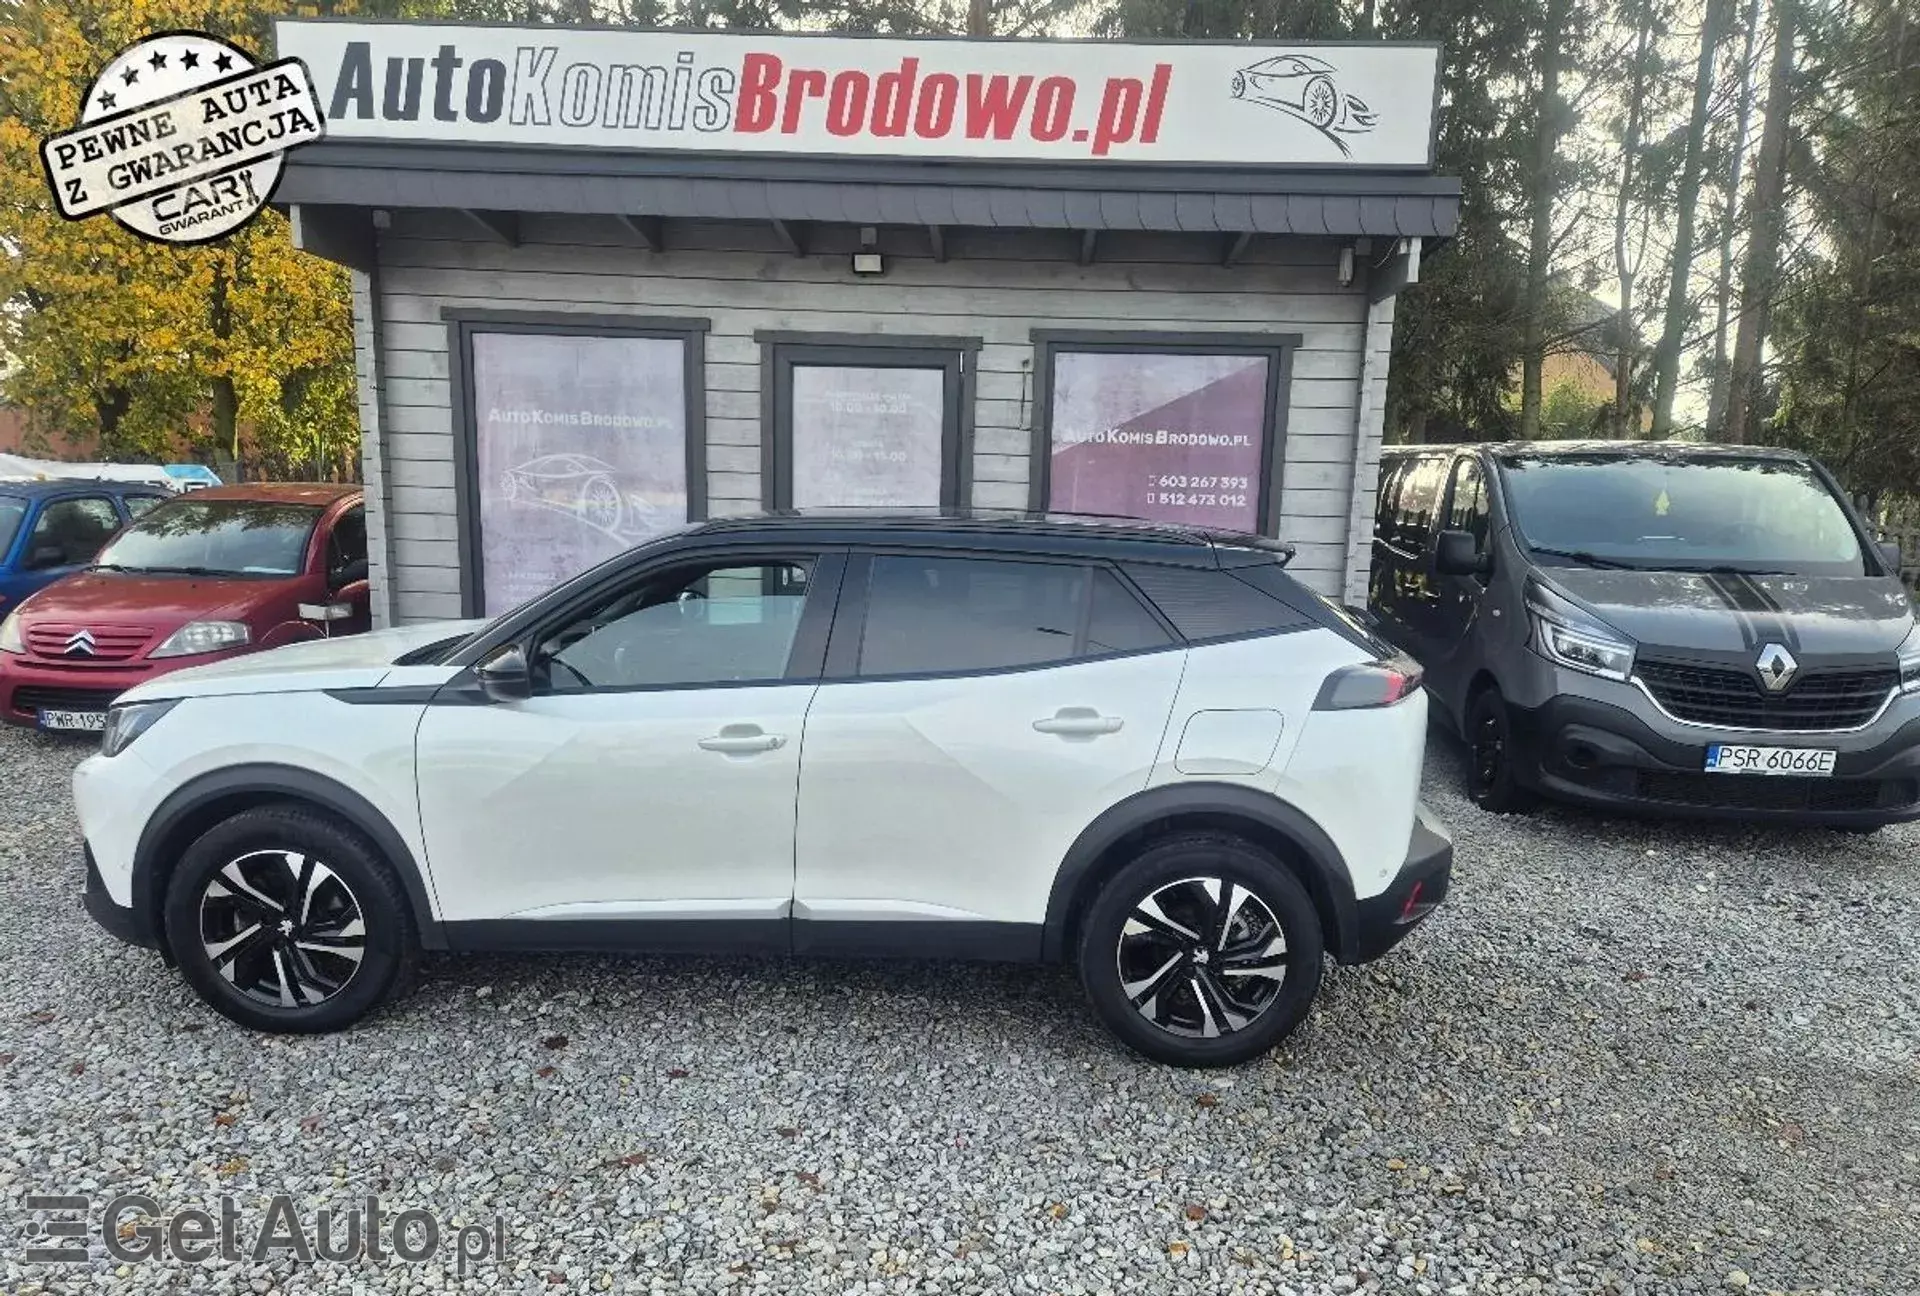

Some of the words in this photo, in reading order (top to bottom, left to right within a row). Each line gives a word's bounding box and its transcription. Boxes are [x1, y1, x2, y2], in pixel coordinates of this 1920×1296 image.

[330, 40, 1174, 158] AutoKomisBrodowo.pl
[1159, 475, 1187, 488] 603
[1190, 475, 1216, 488] 267
[1220, 476, 1248, 488] 393
[1159, 493, 1186, 505] 512
[1189, 494, 1215, 505] 473
[1219, 494, 1246, 506] 012
[46, 712, 75, 727] PWR
[80, 713, 108, 729] 195
[1718, 748, 1761, 768] PSR
[1766, 750, 1833, 771] 6066E
